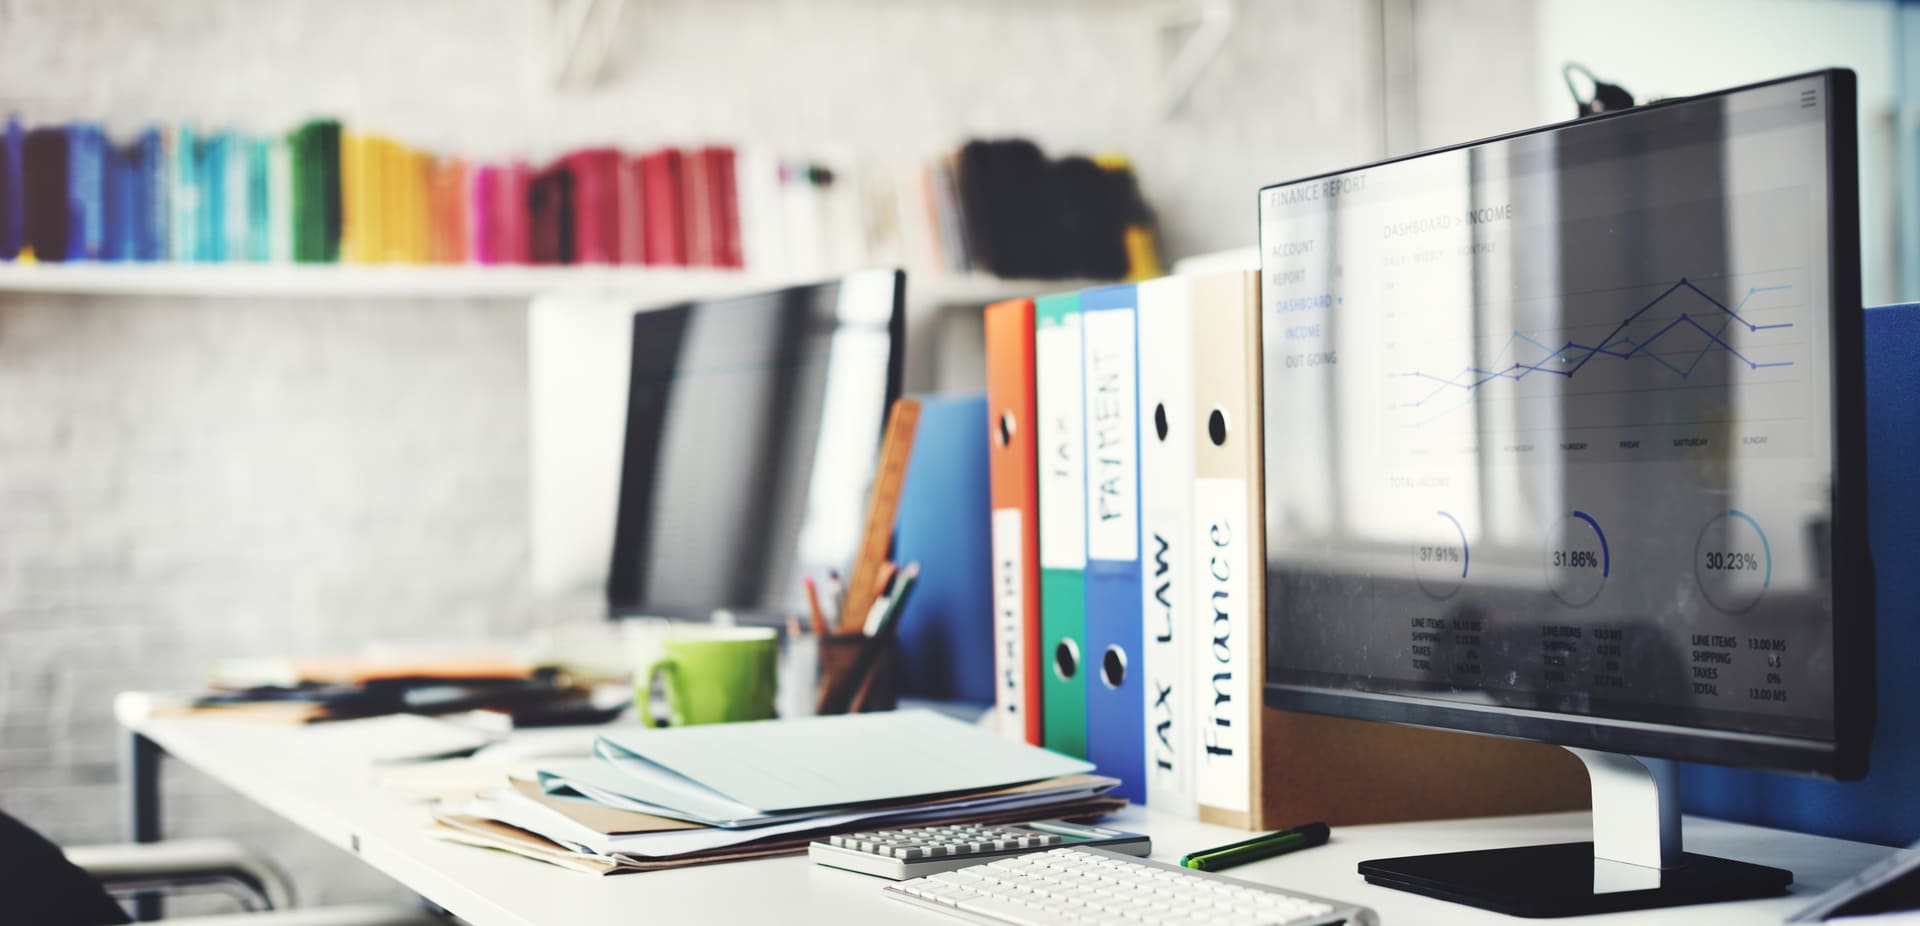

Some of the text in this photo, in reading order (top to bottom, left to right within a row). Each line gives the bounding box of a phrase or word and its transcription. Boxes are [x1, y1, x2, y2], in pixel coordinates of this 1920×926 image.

[1271, 174, 1366, 208] FINANCE REPORT
[1384, 215, 1450, 239] DASHBOARD
[1467, 204, 1512, 224] INCOME
[1272, 240, 1314, 257] ACCOUNT
[1272, 270, 1305, 285] REPORT
[1276, 294, 1332, 313] DASHBOARD
[1285, 324, 1321, 339] INCOME
[1285, 351, 1337, 368] OUT GOING
[1093, 352, 1121, 523] PAYMENT
[1420, 547, 1459, 562] 37.91%
[1553, 551, 1598, 568] 31.86%
[1706, 552, 1758, 571] 30.23%
[1692, 634, 1737, 649] LINE ITEMS
[1153, 532, 1173, 772] TAX LAW
[1692, 650, 1731, 665] SHIPPING
[1692, 666, 1718, 680] TAXES
[1692, 682, 1719, 697] TOTAL
